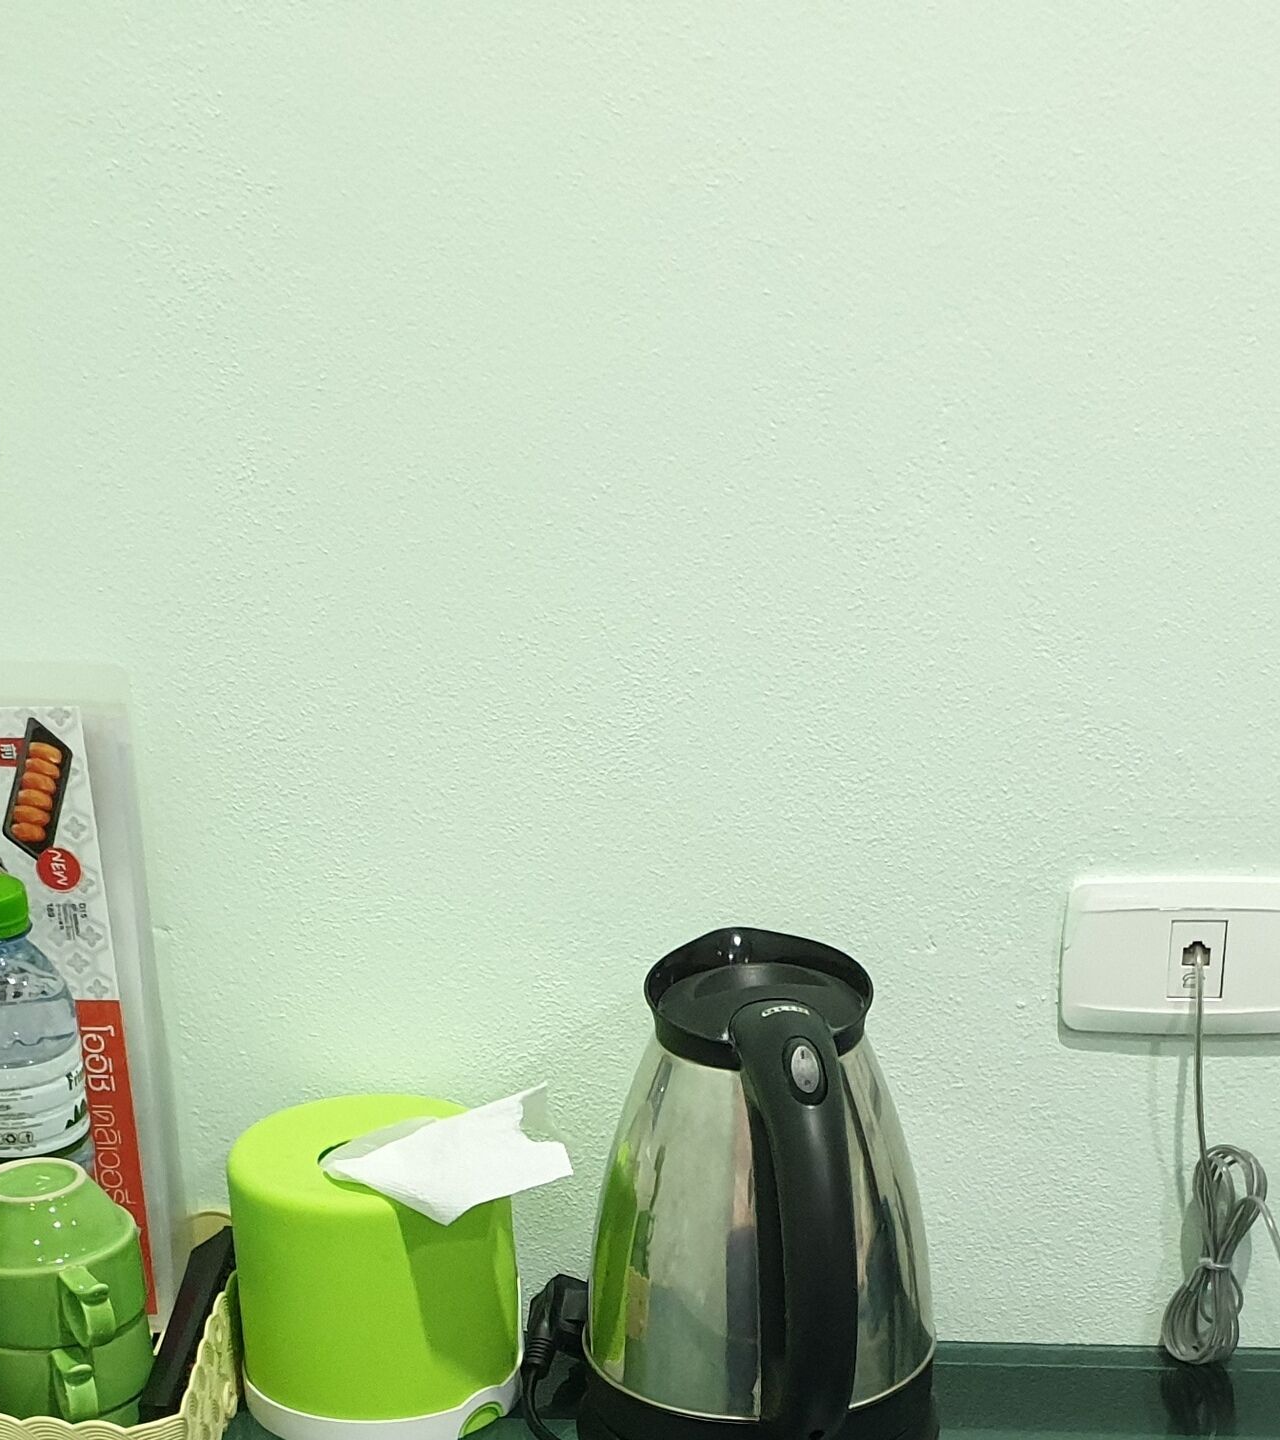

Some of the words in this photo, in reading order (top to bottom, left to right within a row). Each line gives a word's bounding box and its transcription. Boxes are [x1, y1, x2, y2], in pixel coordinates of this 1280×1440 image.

[47, 849, 69, 887] NEW
[80, 1023, 116, 1092] โออิชิ
